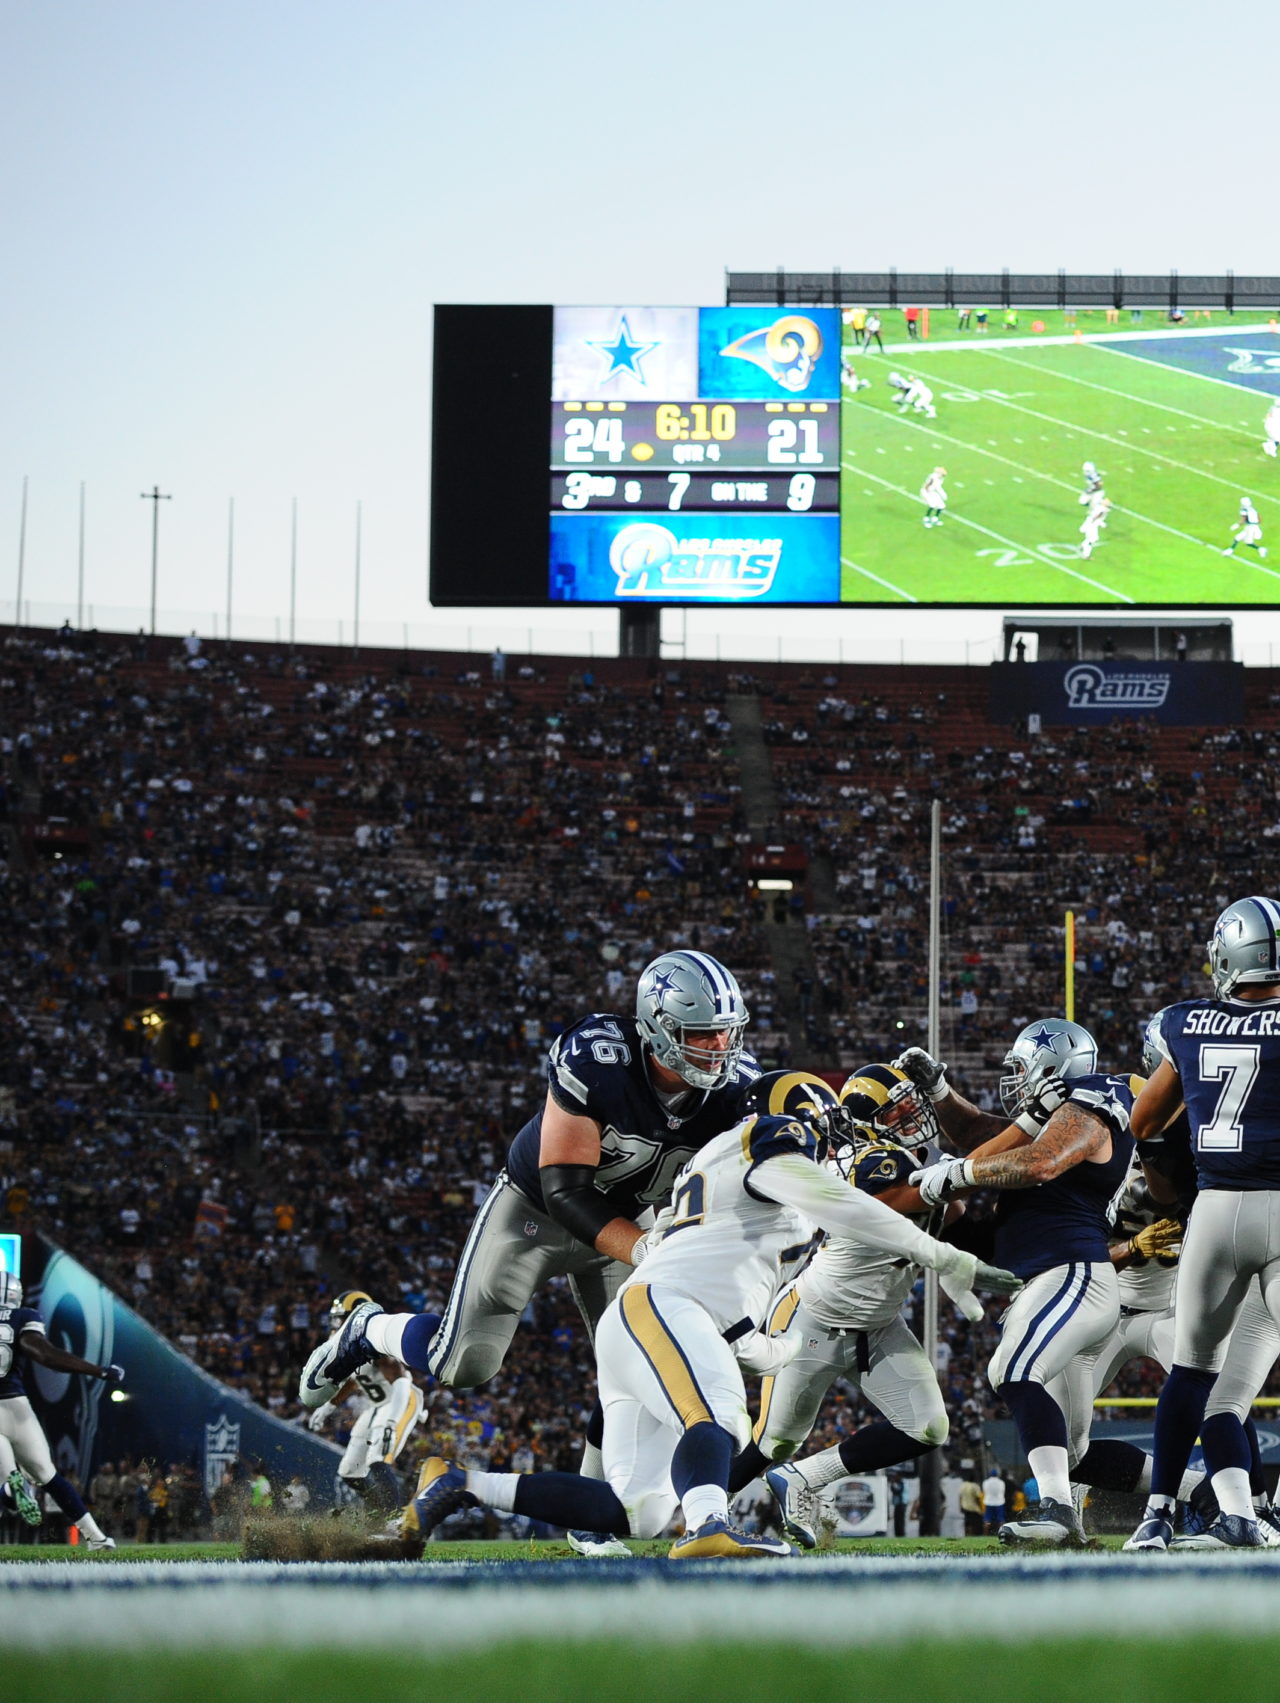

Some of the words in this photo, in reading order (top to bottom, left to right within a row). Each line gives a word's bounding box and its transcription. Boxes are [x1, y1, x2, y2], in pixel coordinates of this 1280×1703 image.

[564, 418, 626, 463] 24
[656, 404, 737, 441] 6:10
[767, 419, 824, 464] 21
[706, 443, 721, 462] 4
[667, 473, 691, 511] 7
[787, 473, 816, 511] 9
[580, 1021, 632, 1066] 76
[1198, 1043, 1261, 1153] 7
